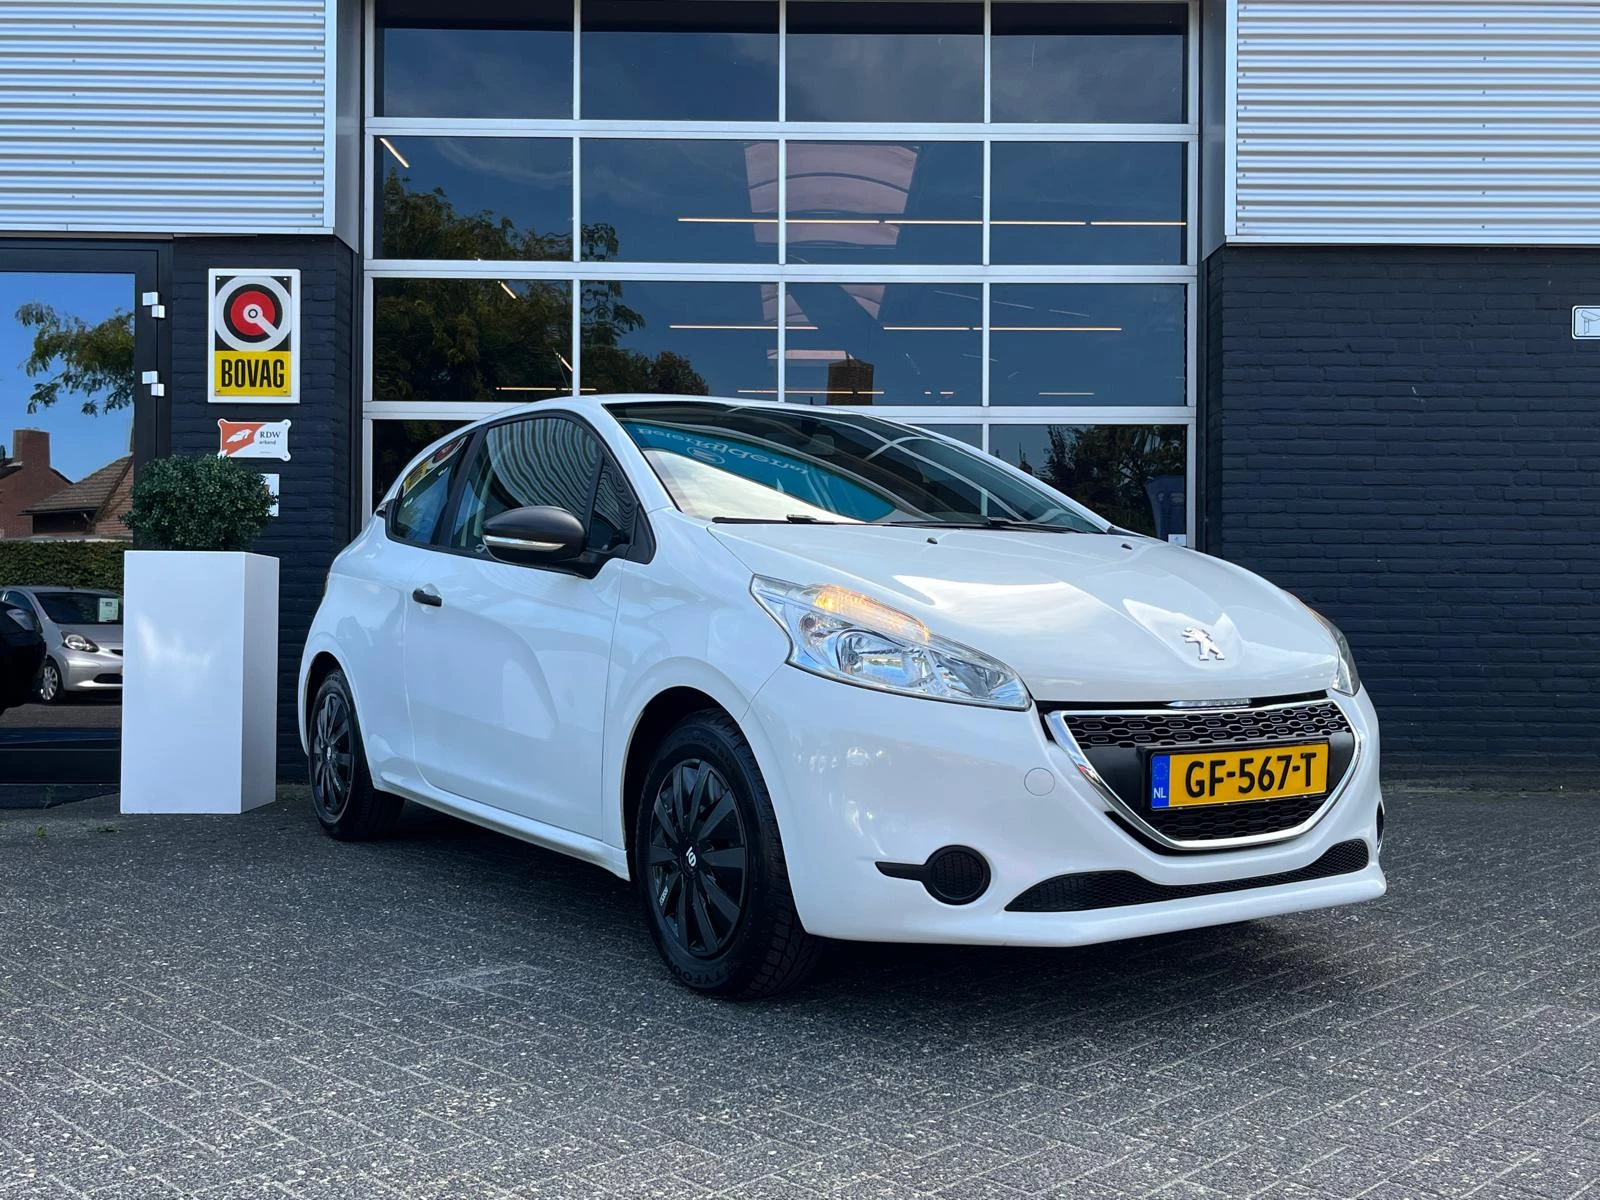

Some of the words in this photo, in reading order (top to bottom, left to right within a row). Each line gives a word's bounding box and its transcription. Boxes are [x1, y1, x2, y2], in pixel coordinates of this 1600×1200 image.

[221, 359, 285, 388] BOVAG
[1185, 752, 1317, 798] GF-567-T
[1153, 787, 1167, 799] NL
